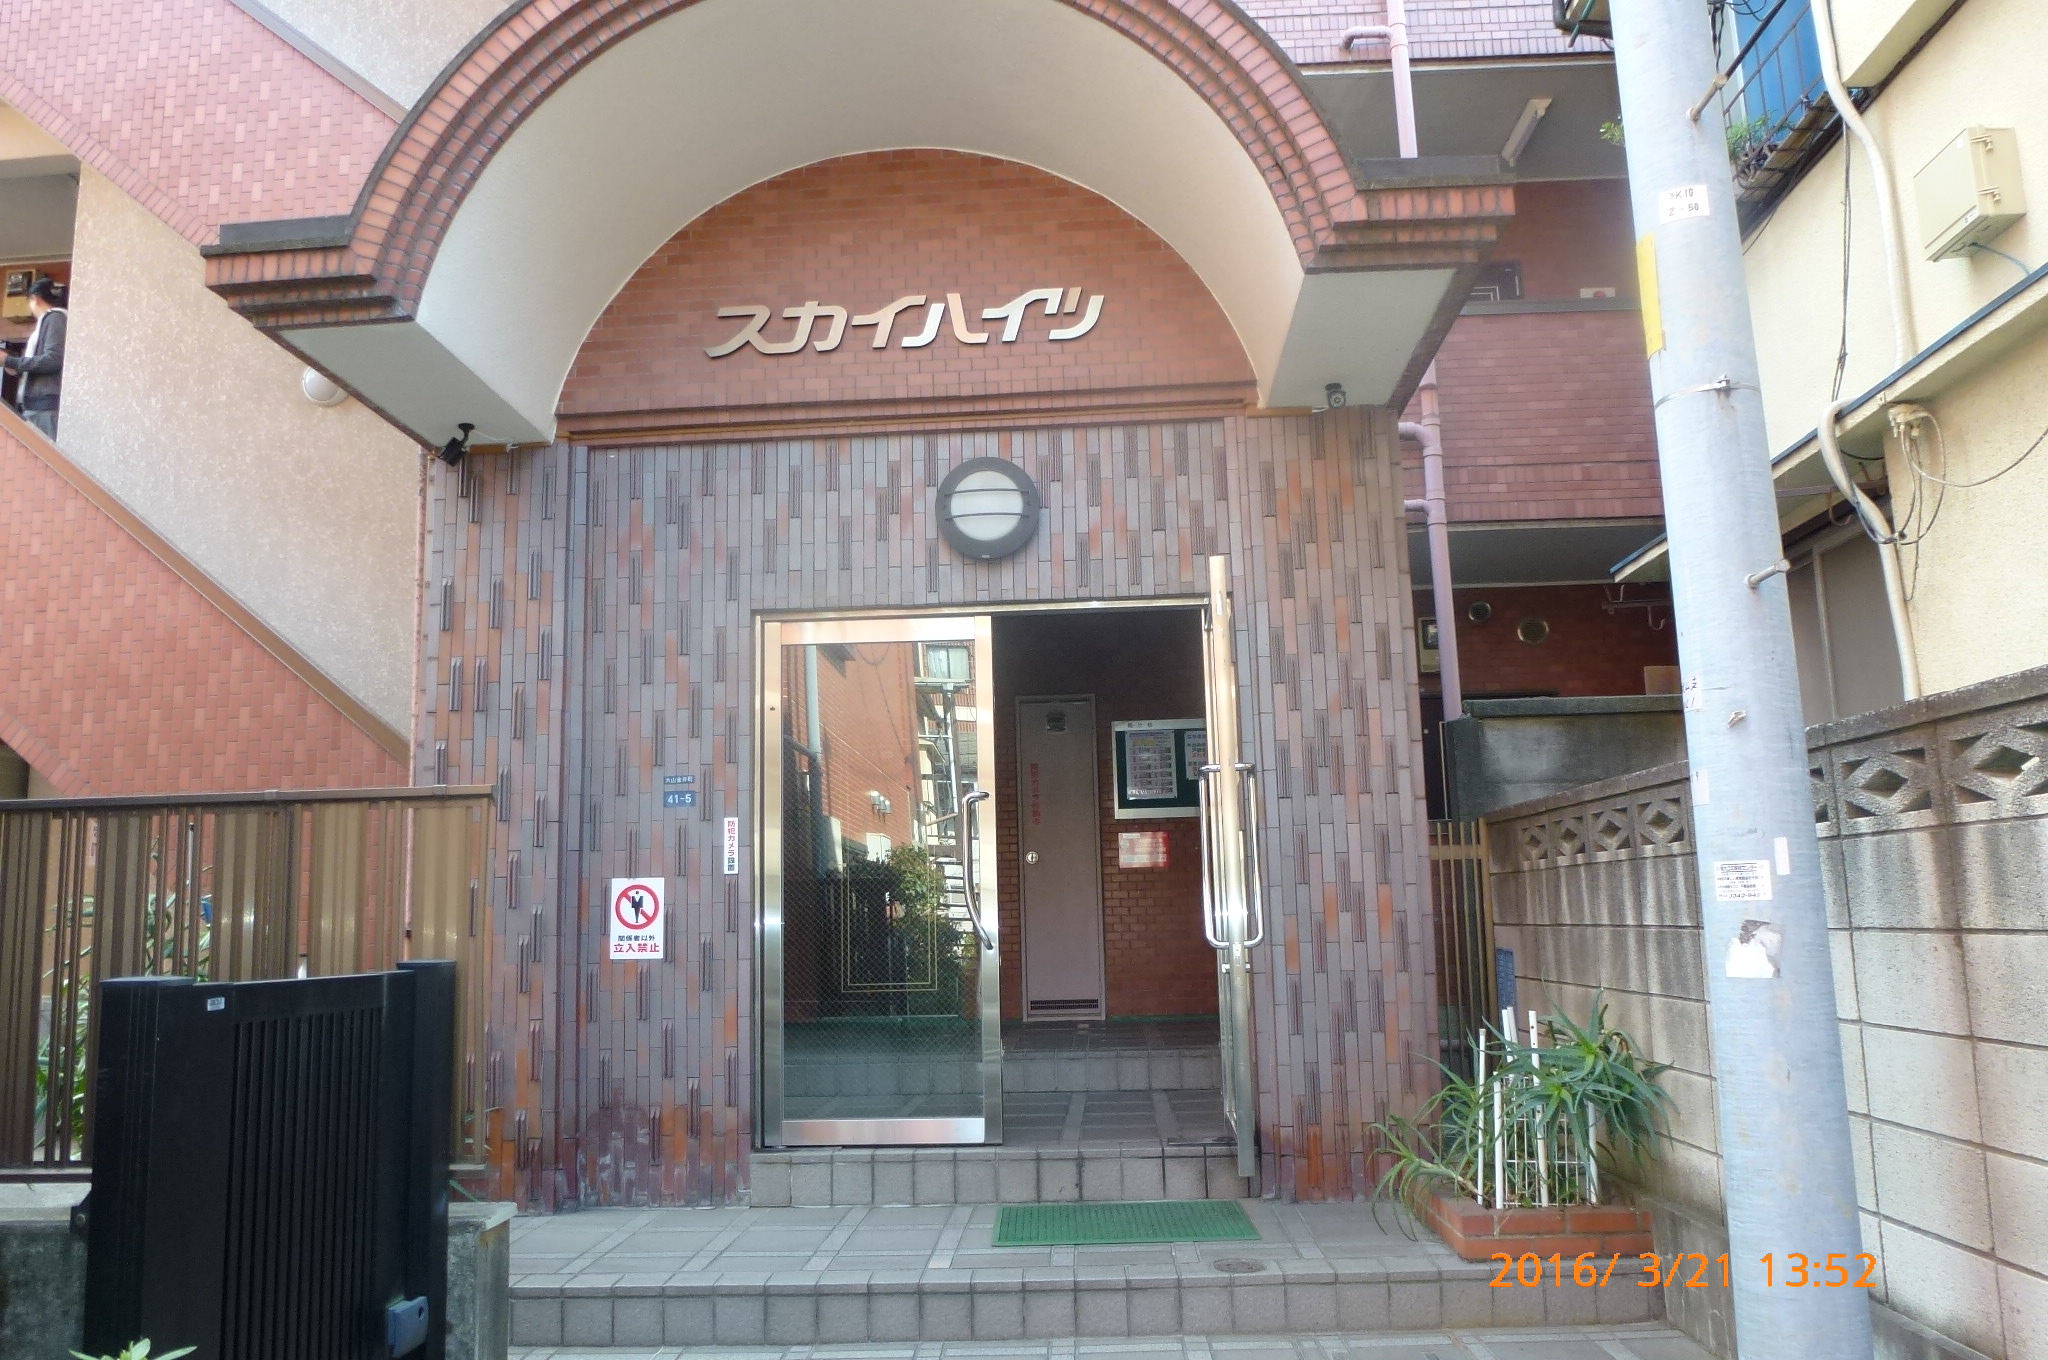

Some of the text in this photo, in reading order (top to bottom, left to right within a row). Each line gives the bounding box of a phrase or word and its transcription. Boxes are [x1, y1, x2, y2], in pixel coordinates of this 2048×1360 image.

[704, 286, 1104, 358] スカイハイツ
[667, 793, 692, 804] 41-5
[727, 820, 736, 872] 防犯カメラ設置
[617, 934, 656, 942] 関係者以外
[613, 942, 660, 953] 立入禁止
